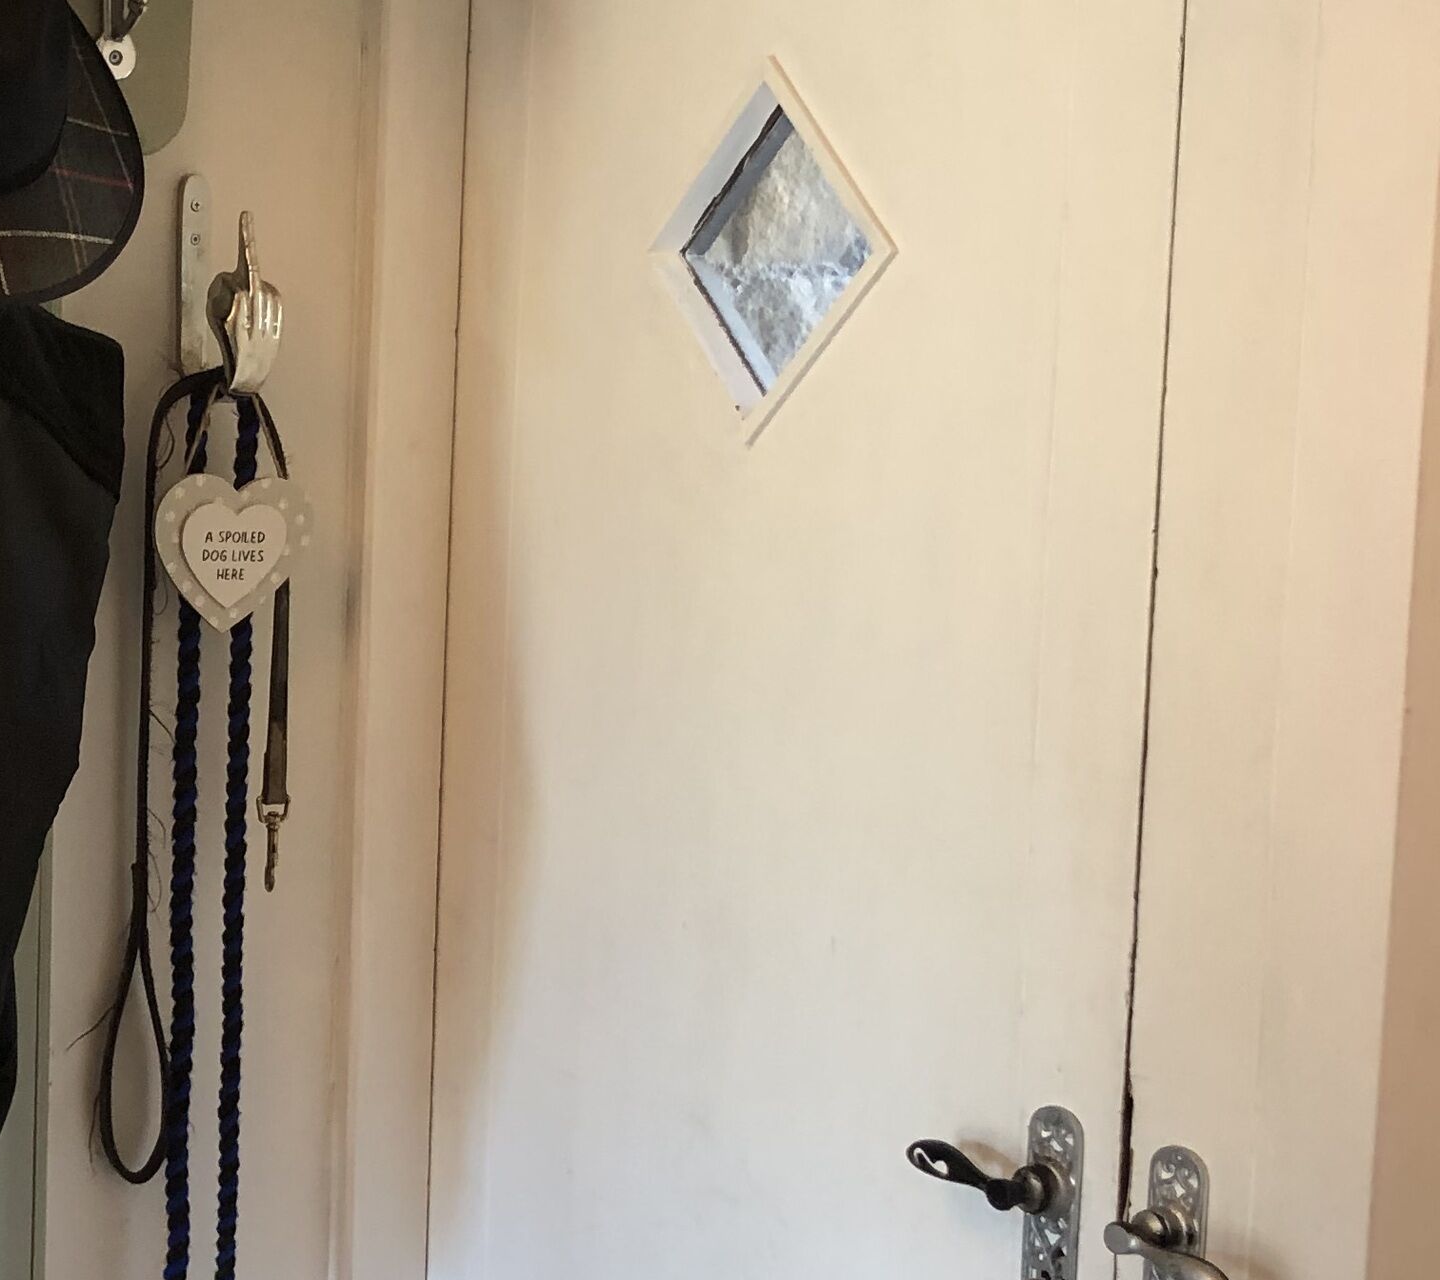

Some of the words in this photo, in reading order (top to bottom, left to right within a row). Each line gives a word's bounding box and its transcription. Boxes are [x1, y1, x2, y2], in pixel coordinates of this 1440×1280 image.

[205, 532, 213, 543] A
[218, 531, 266, 544] SPOILED
[202, 549, 227, 562] DOG
[231, 549, 264, 562] LIVES
[216, 568, 245, 581] HERE
